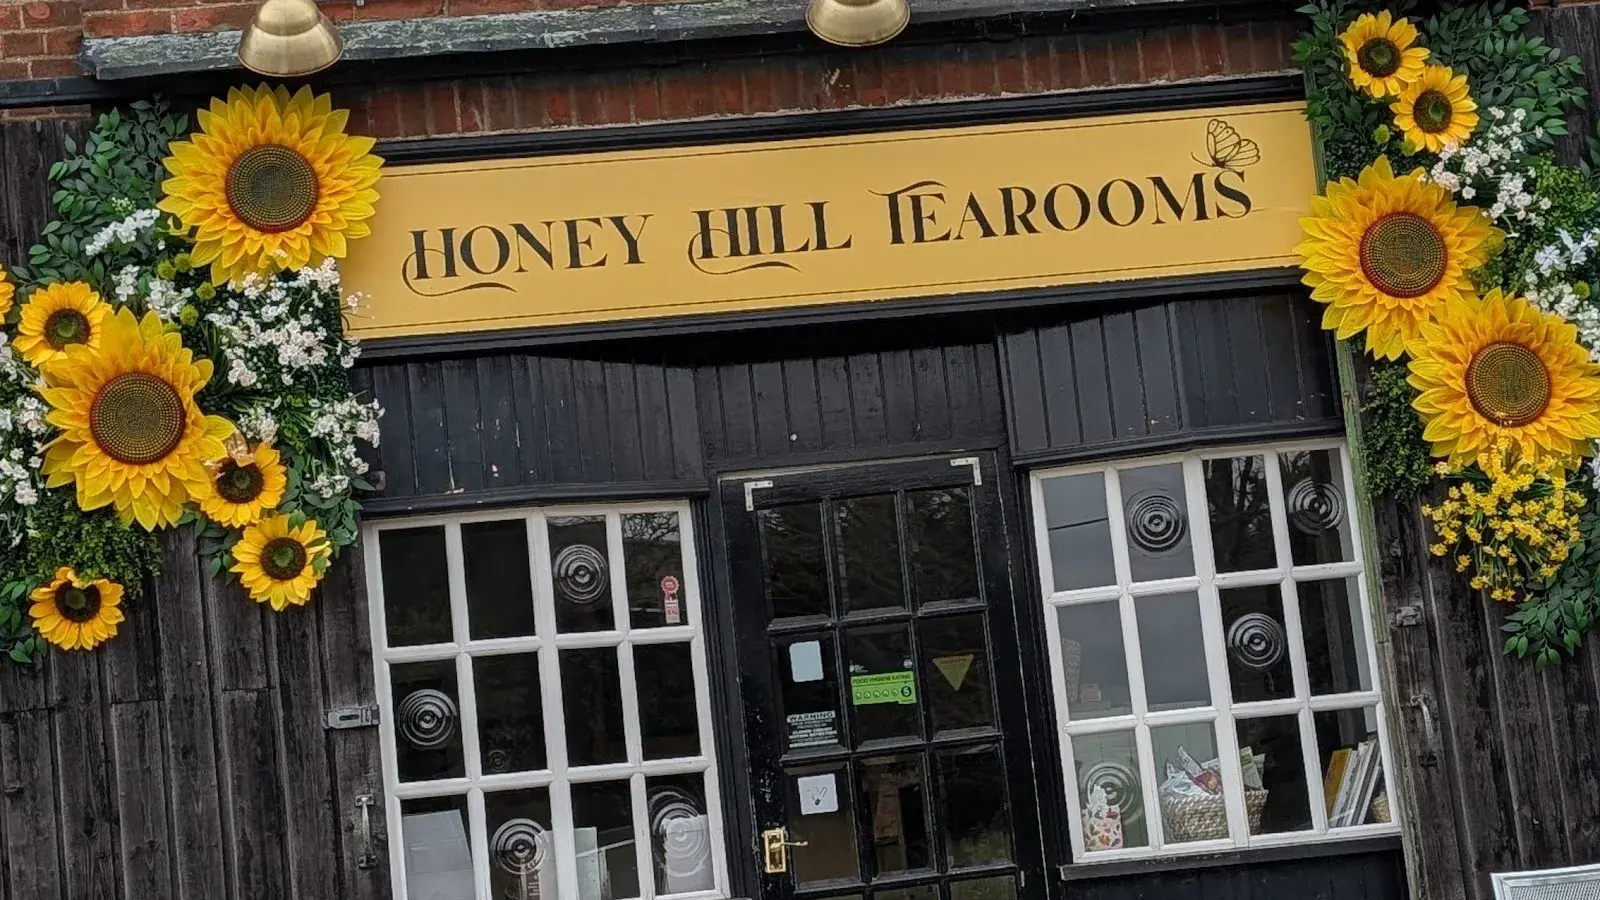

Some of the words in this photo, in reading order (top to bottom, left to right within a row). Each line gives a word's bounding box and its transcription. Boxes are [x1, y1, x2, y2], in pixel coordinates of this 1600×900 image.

[402, 214, 654, 297] HONEY
[688, 201, 852, 275] HILL
[868, 170, 1252, 245] TEAROOMS
[790, 712, 833, 721] WARNING
